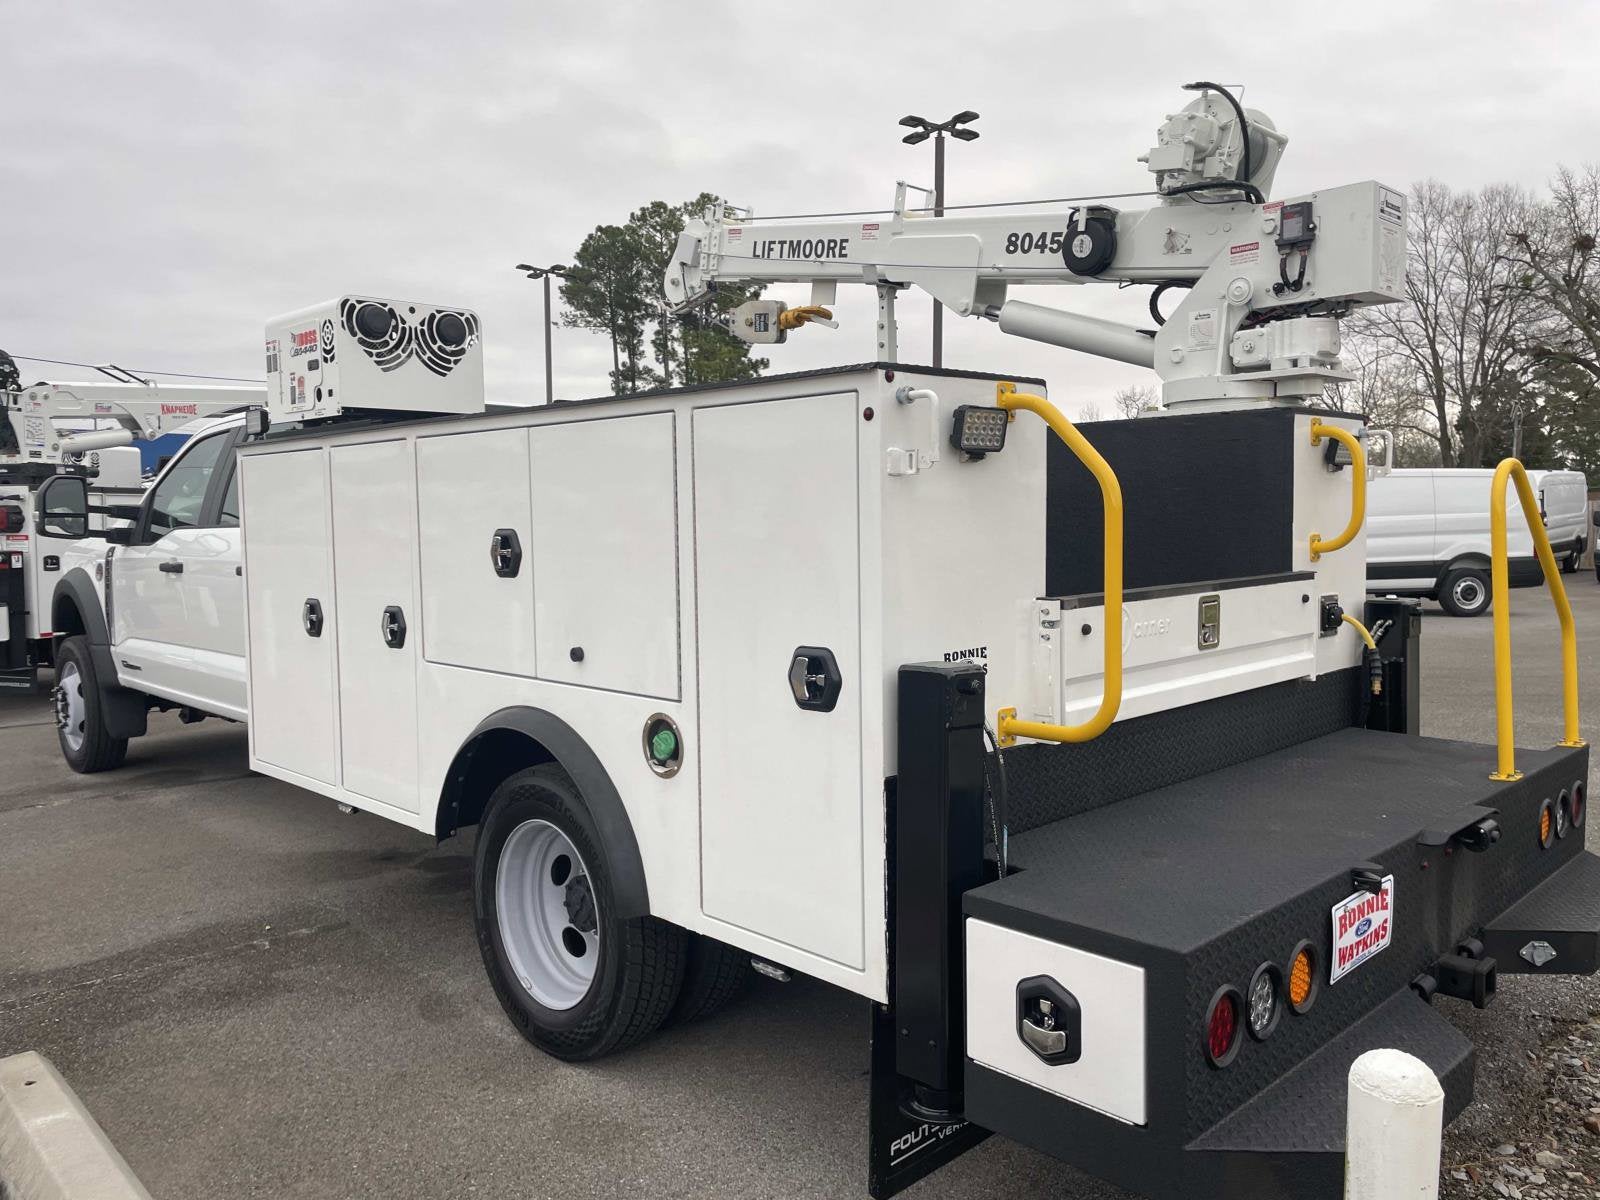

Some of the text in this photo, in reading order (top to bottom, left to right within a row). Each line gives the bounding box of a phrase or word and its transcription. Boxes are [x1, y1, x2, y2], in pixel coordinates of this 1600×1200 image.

[752, 238, 849, 259] LIFTMOORE
[1005, 231, 1063, 255] 8045
[943, 646, 988, 663] RONNIE
[1338, 888, 1389, 941] RONNIE
[1338, 918, 1389, 969] WATKINS
